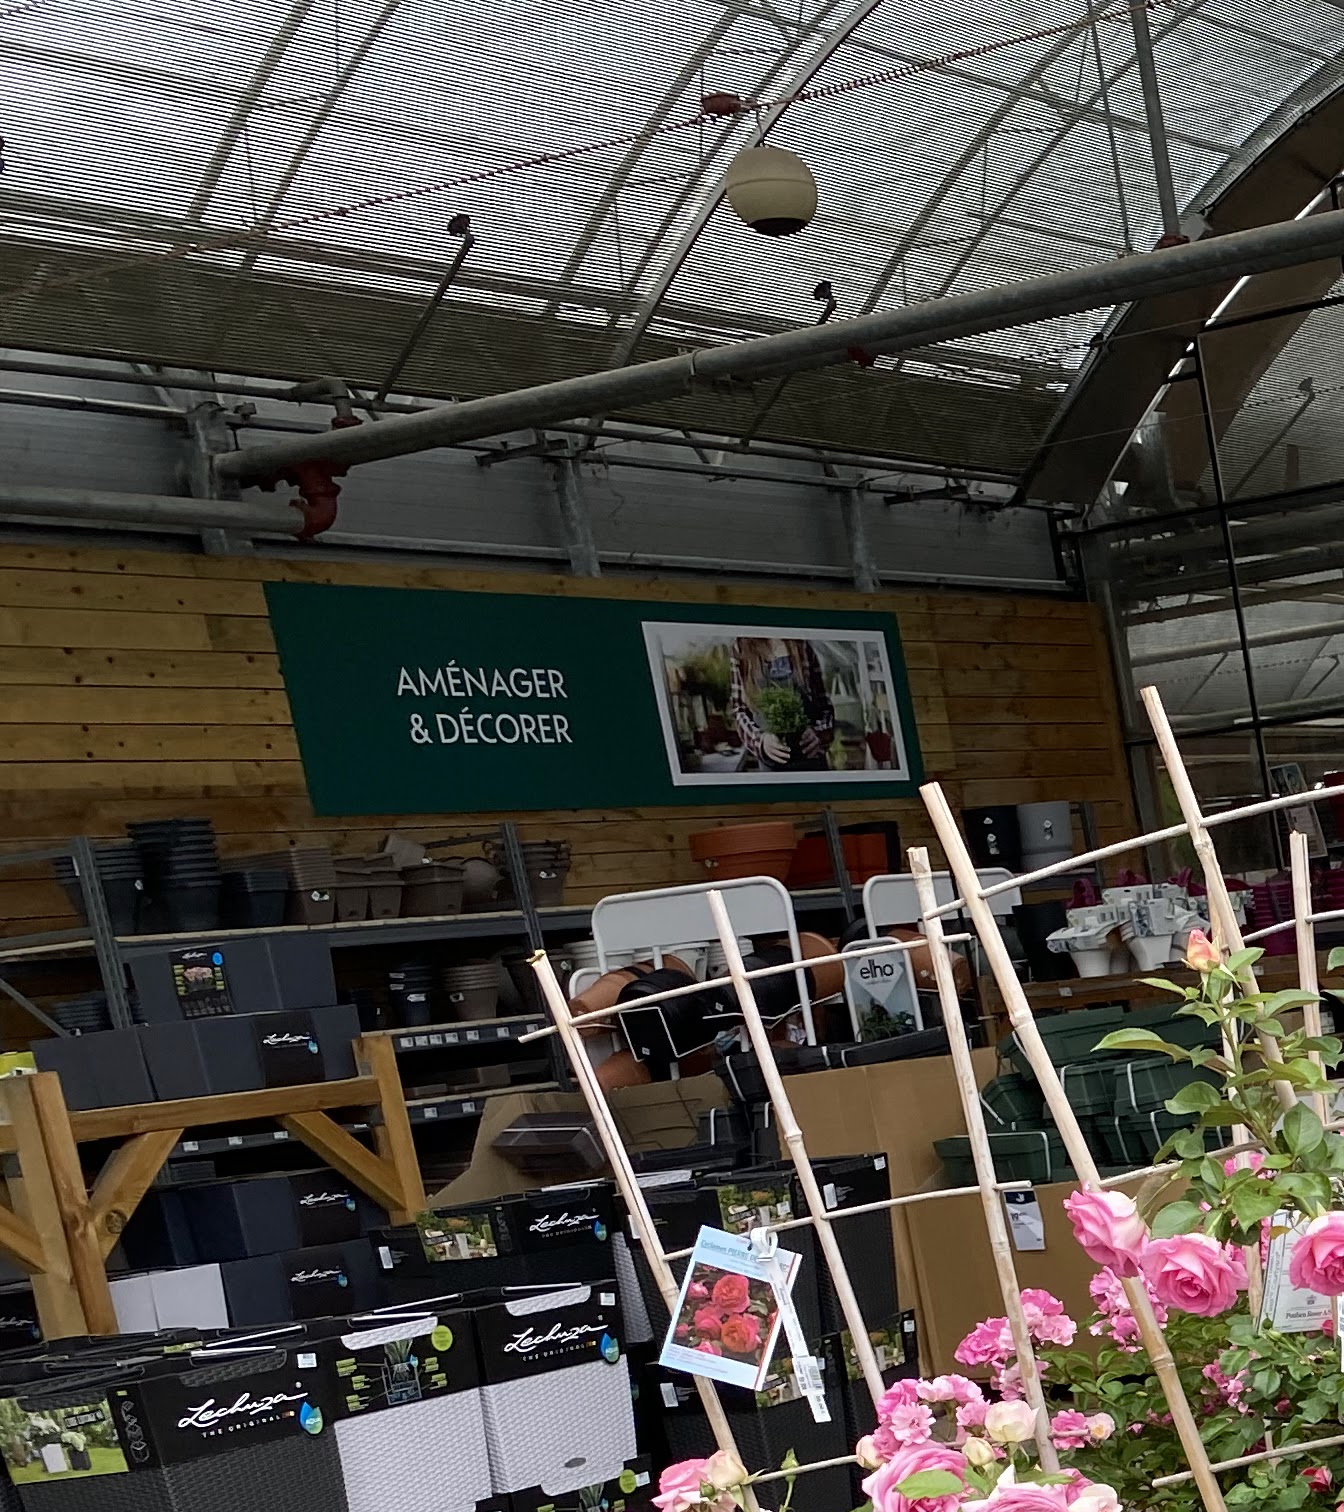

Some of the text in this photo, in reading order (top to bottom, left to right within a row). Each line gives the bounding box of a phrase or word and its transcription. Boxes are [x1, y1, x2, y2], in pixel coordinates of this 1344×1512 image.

[397, 659, 568, 699] AMÉNAGER
[410, 706, 573, 744] & DÉCORER
[860, 959, 894, 979] elho
[503, 1322, 609, 1353] Lechuza
[177, 1392, 309, 1428] Lechuza
